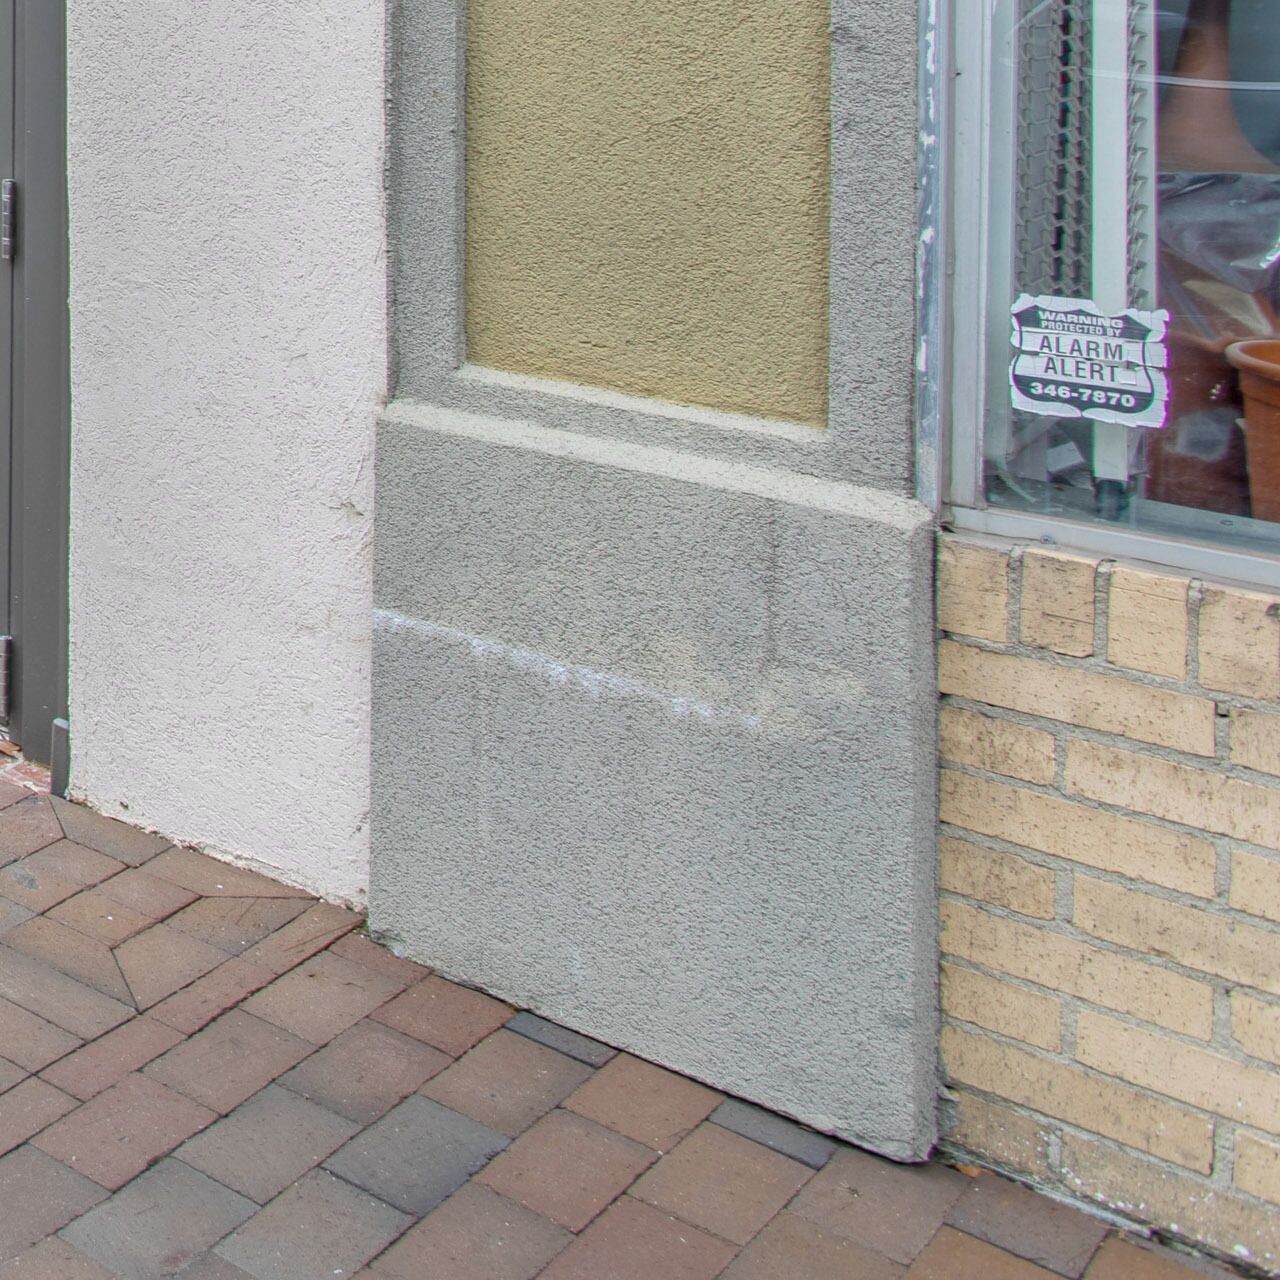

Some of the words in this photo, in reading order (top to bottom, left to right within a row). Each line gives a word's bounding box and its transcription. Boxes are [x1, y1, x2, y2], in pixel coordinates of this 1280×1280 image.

[1038, 310, 1124, 328] WARNING
[1041, 321, 1103, 335] PROTECTED
[1107, 327, 1121, 337] BY
[1039, 335, 1123, 361] ALARM
[1043, 356, 1120, 383] ALERT
[1030, 382, 1136, 407] 346-7870
